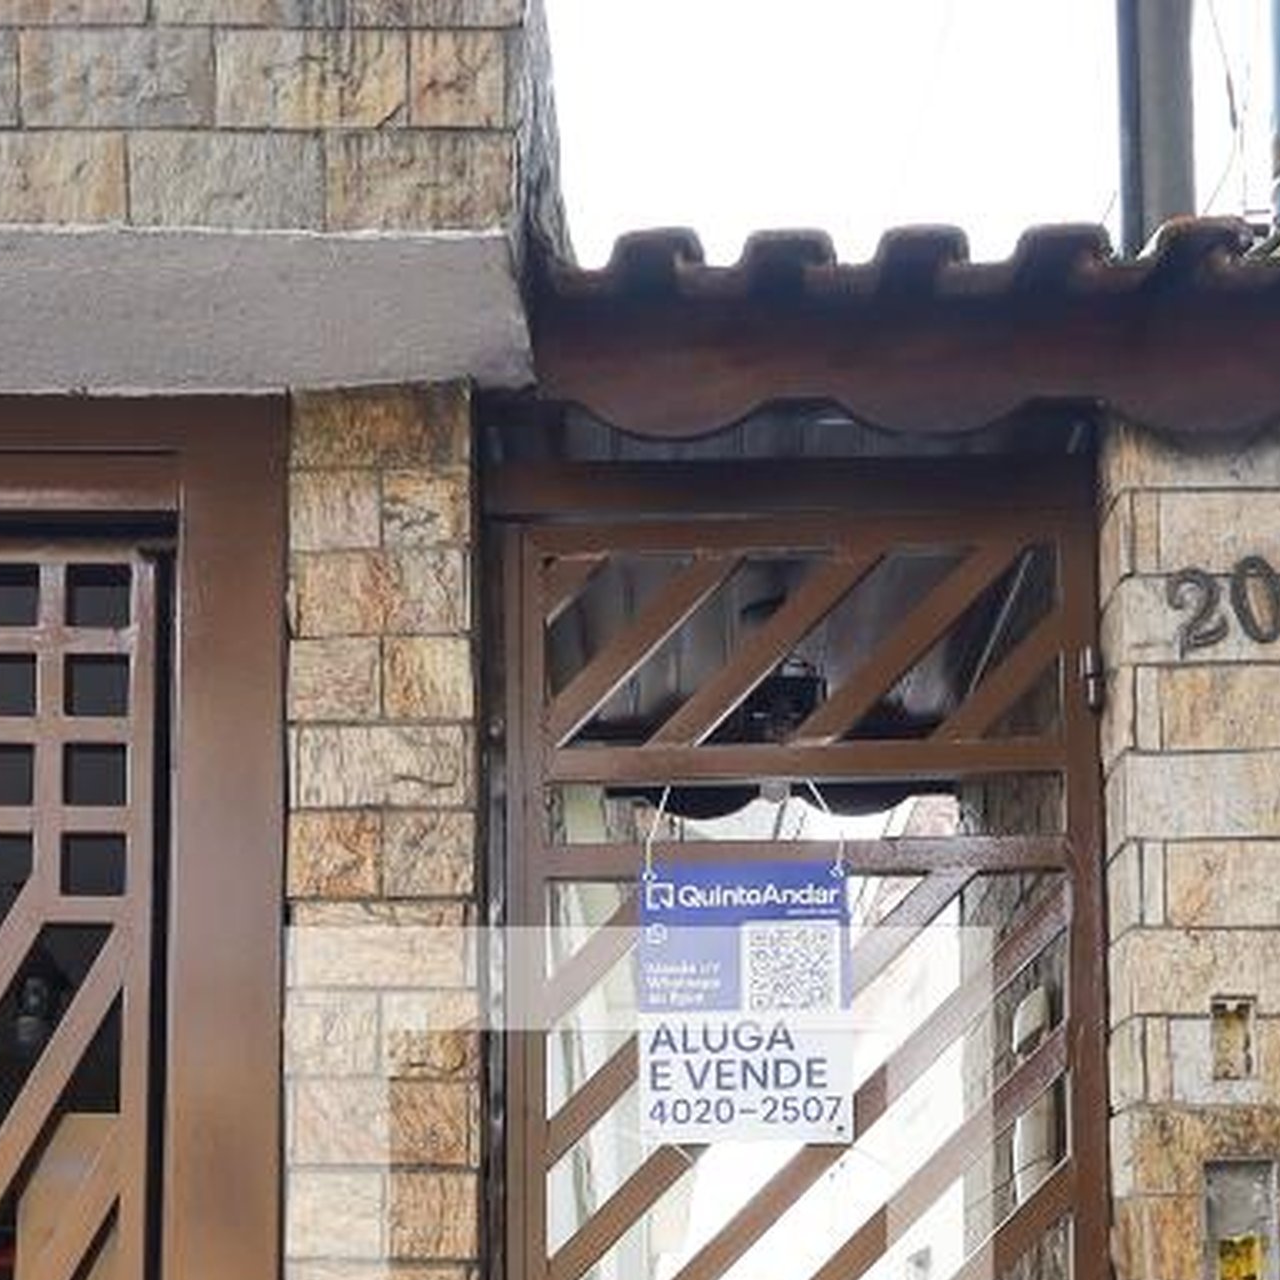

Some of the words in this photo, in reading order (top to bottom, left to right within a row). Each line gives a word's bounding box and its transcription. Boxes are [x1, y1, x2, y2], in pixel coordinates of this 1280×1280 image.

[677, 882, 840, 908] QuintoAndar
[649, 1020, 796, 1055] ALUGA
[650, 1061, 672, 1092] E
[685, 1057, 829, 1092] VENDE
[648, 1095, 843, 1126] 4020-2507
